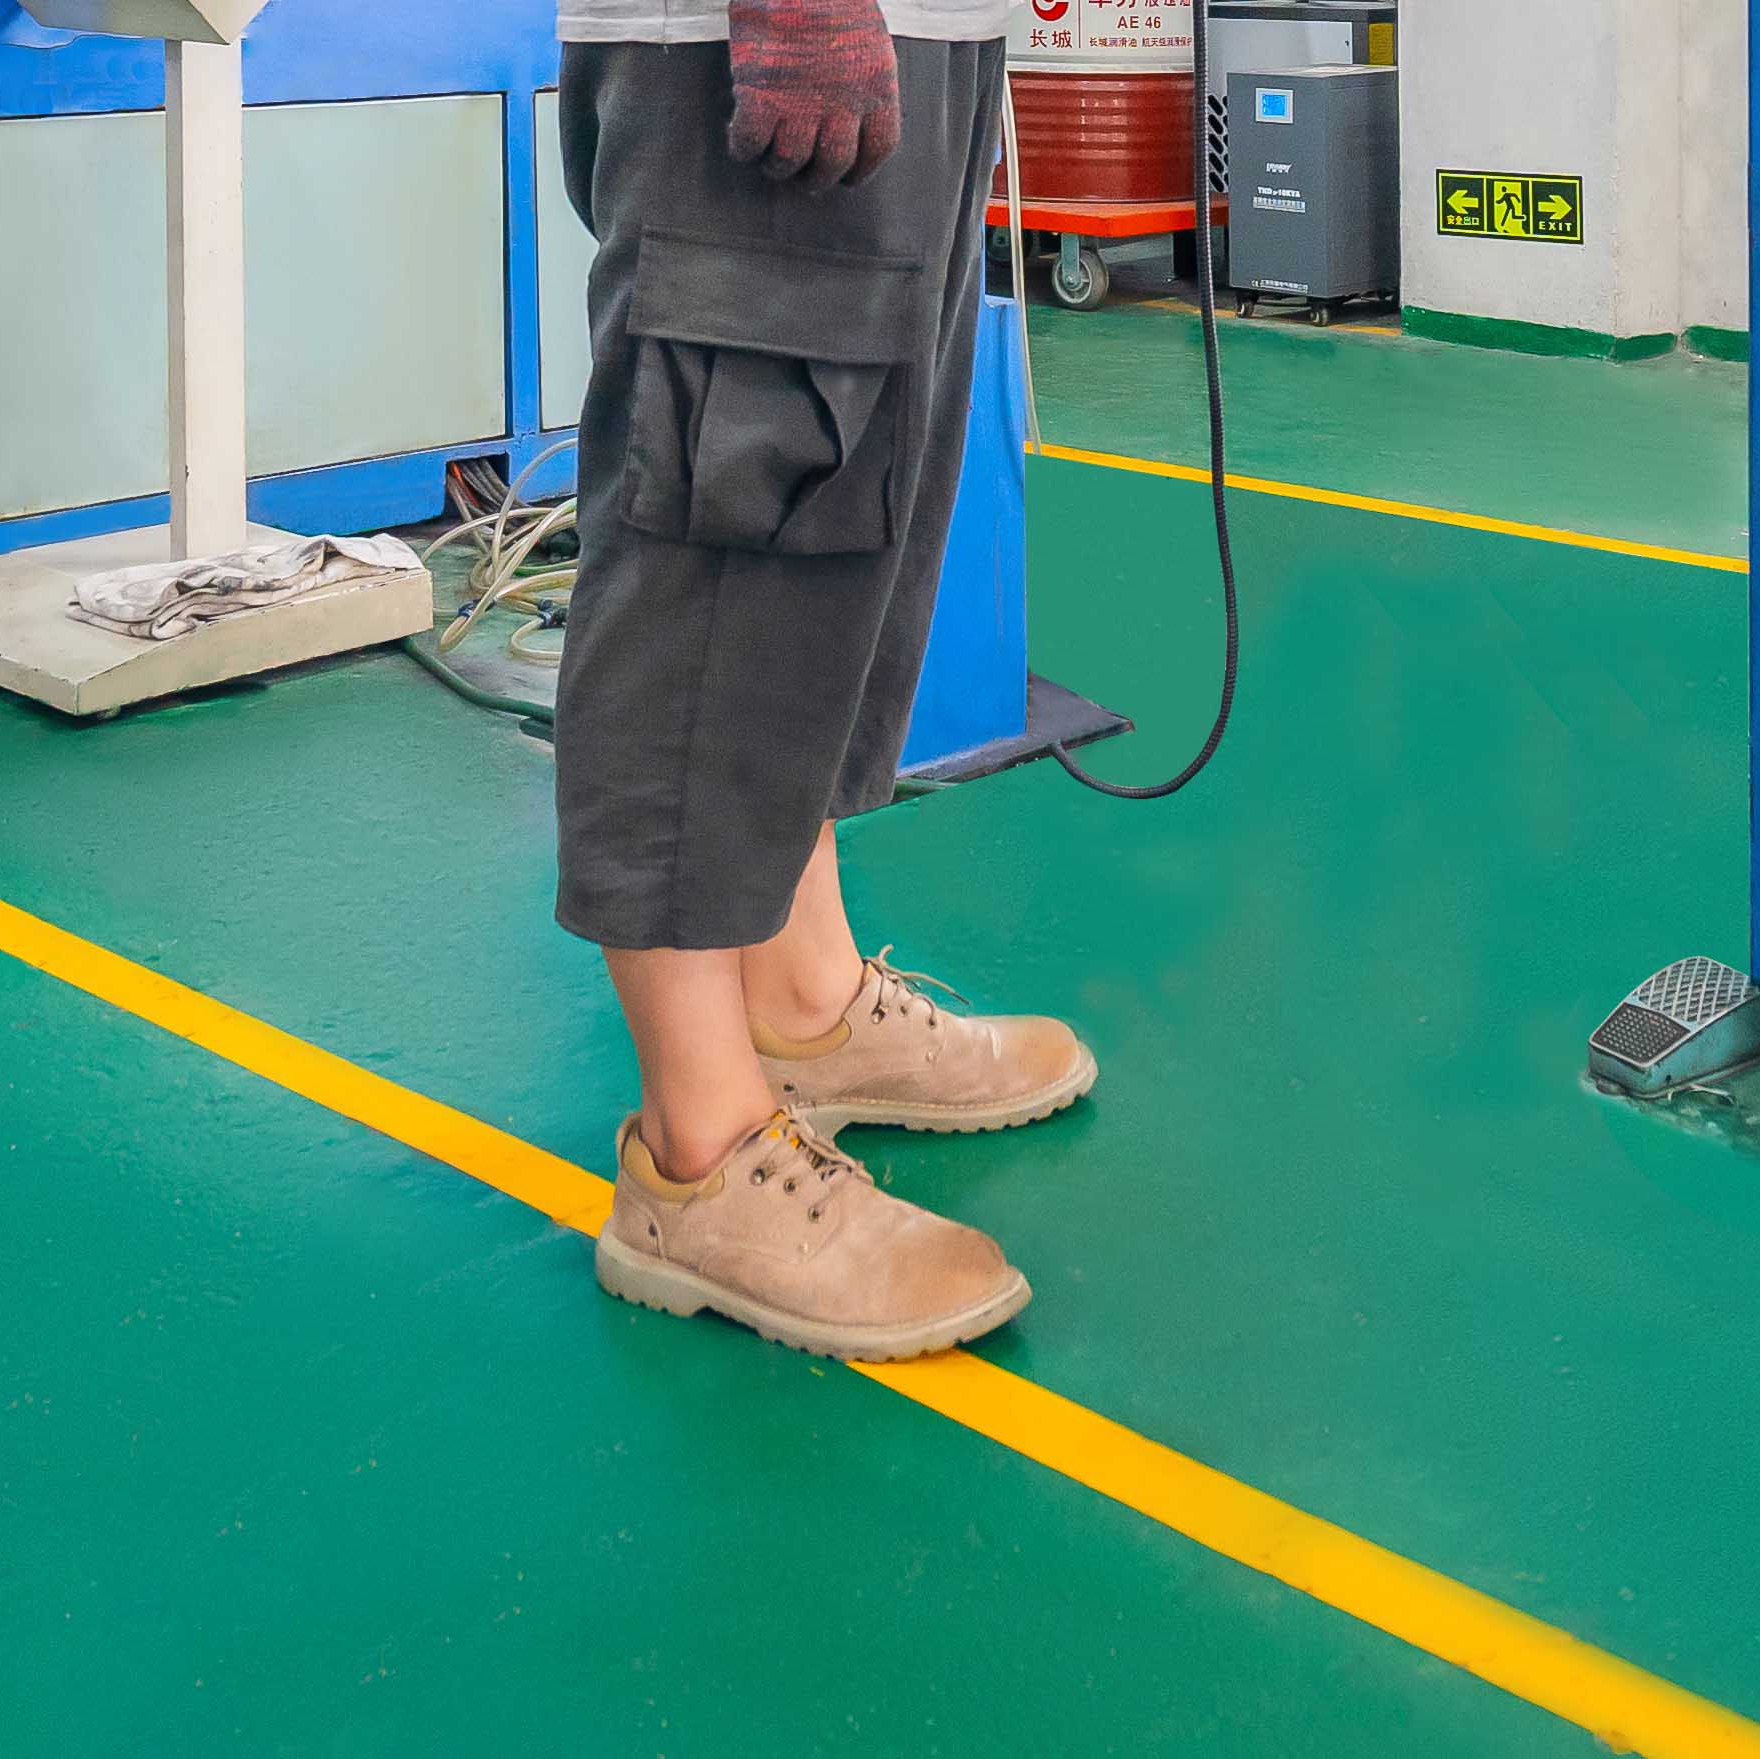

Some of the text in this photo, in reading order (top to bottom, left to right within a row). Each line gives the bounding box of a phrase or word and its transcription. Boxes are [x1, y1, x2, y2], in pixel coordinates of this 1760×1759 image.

[1117, 16, 1161, 29] AE 46
[1030, 28, 1073, 49] 长城
[1089, 36, 1138, 48] 长城润滑油
[1538, 221, 1573, 232] EXIT
